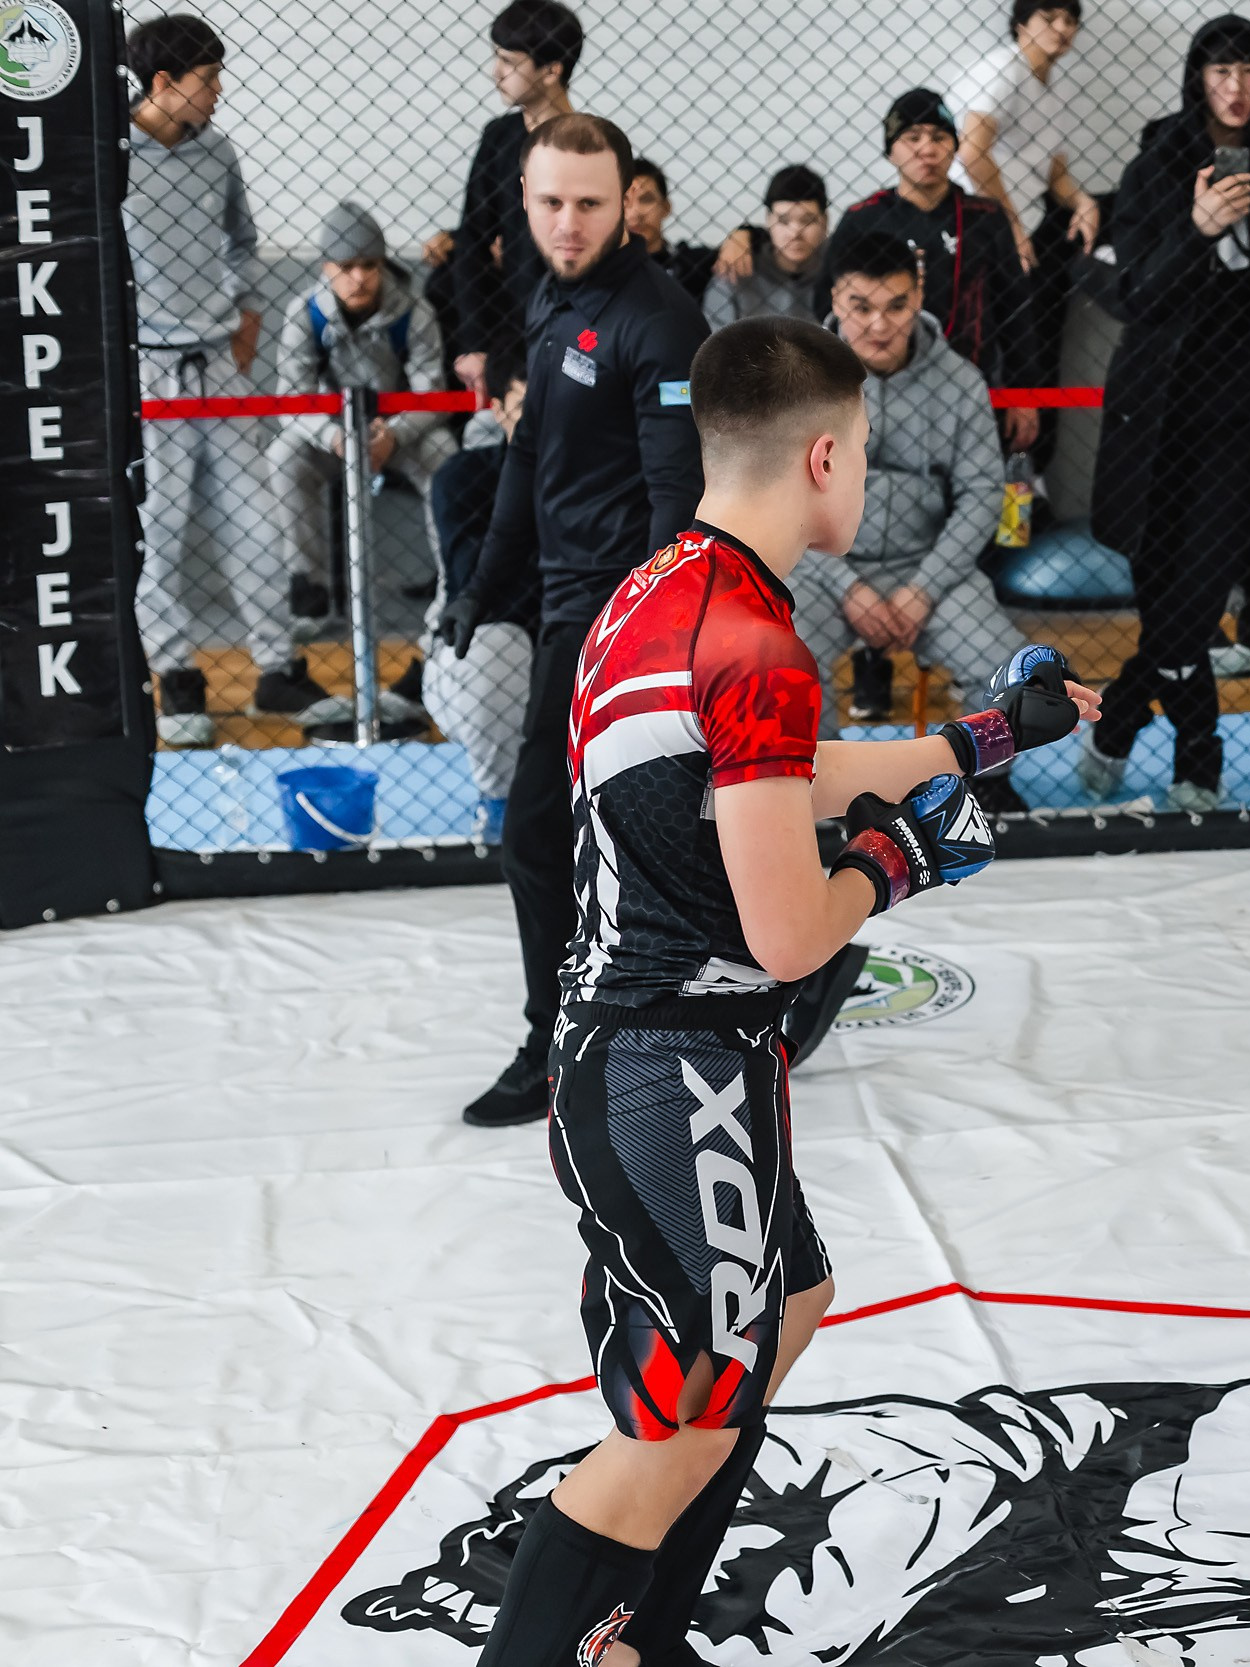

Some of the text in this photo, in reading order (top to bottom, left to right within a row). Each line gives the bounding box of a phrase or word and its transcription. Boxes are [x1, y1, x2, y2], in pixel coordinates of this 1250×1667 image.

[13, 116, 64, 461] JEKPE
[36, 501, 83, 698] JEK
[894, 816, 928, 868] IMMAF
[677, 1055, 767, 1374] RDX
